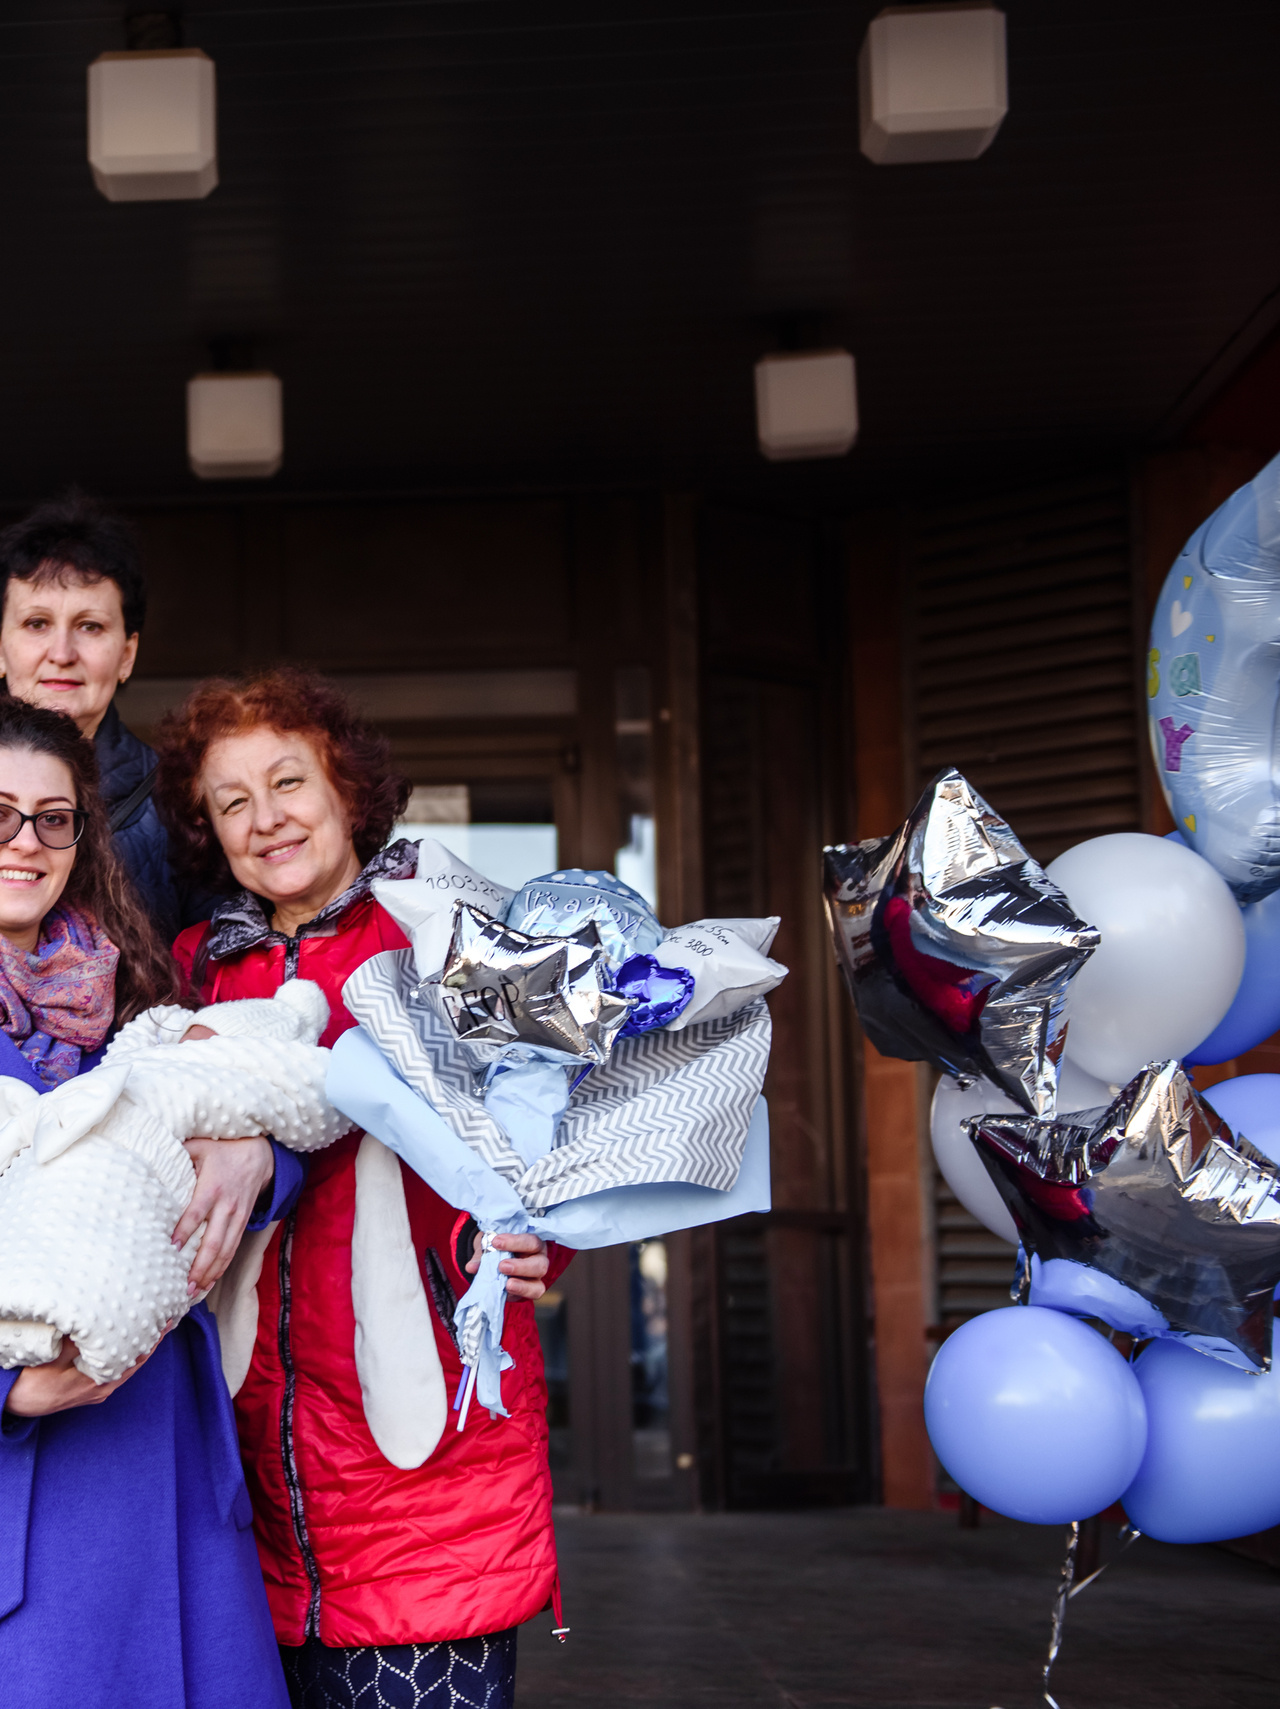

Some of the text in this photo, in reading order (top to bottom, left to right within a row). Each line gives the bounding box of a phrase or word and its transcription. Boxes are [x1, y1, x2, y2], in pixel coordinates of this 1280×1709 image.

[1157, 715, 1196, 773] Y
[523, 887, 560, 917] It's
[563, 898, 581, 914] a
[586, 894, 646, 940] Boy!
[684, 938, 714, 957] 3800
